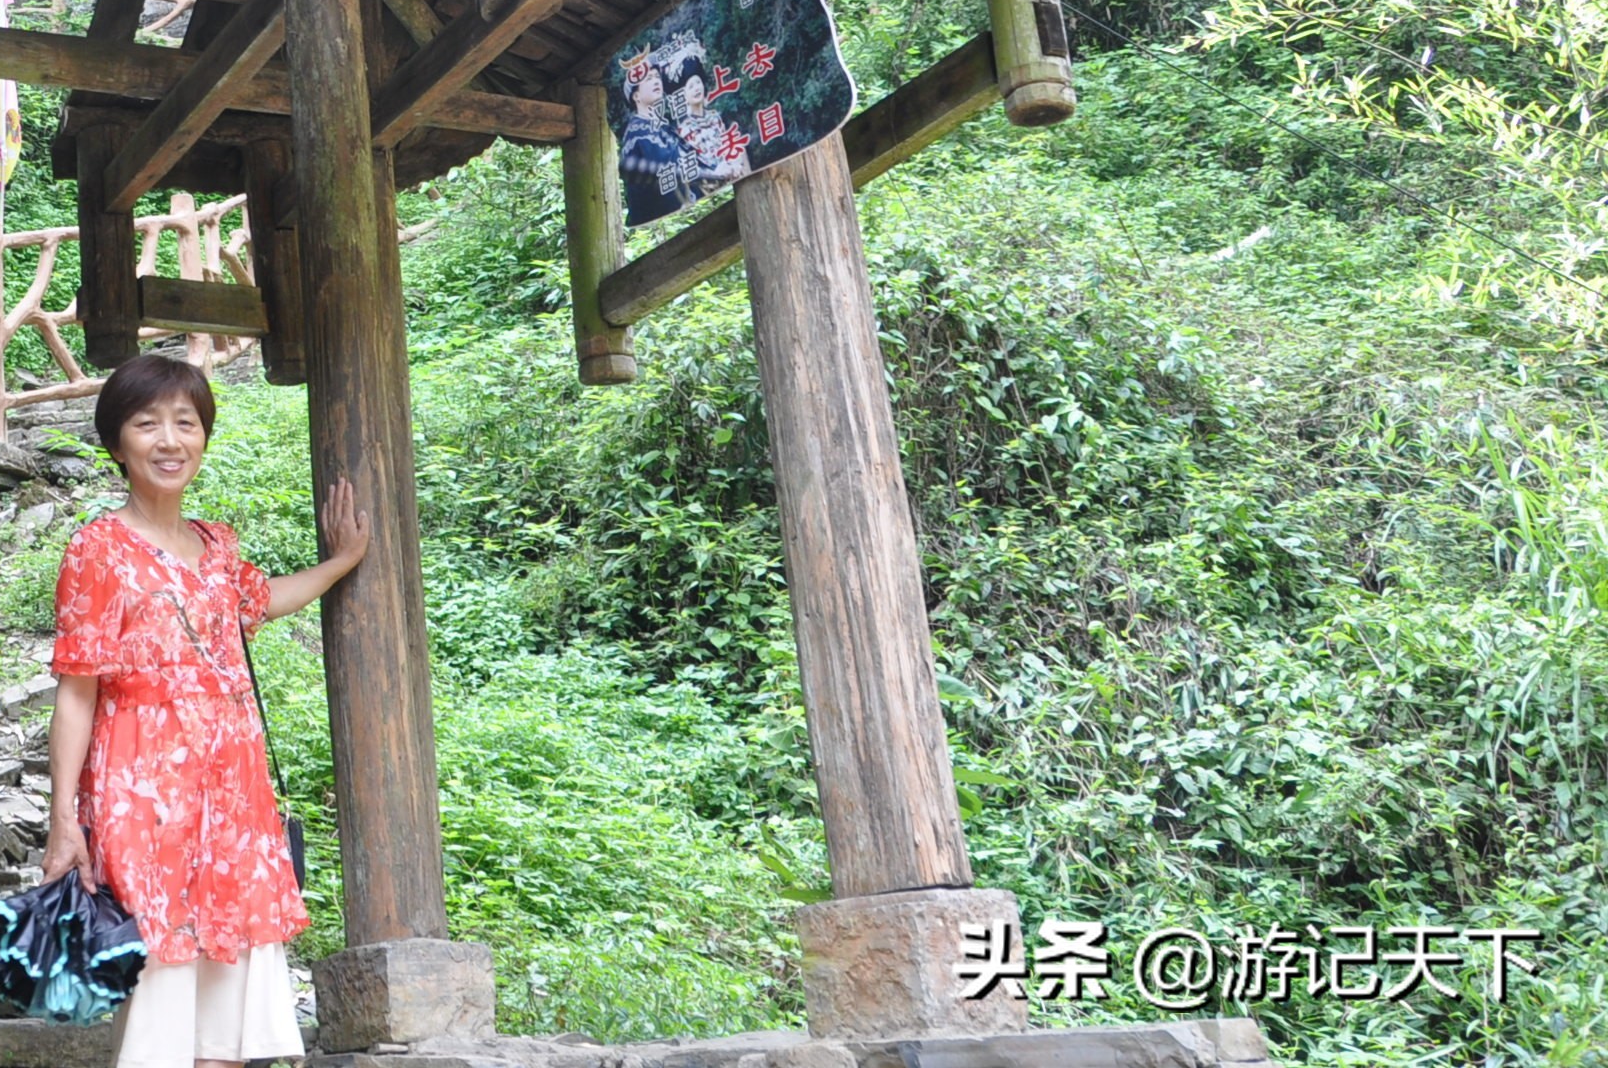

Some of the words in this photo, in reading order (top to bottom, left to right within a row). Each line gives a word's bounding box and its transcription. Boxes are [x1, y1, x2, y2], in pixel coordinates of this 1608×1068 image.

[648, 88, 689, 132] 汉语
[706, 41, 777, 104] 上去
[657, 151, 699, 196] 苗语
[717, 102, 785, 162] 丢目
